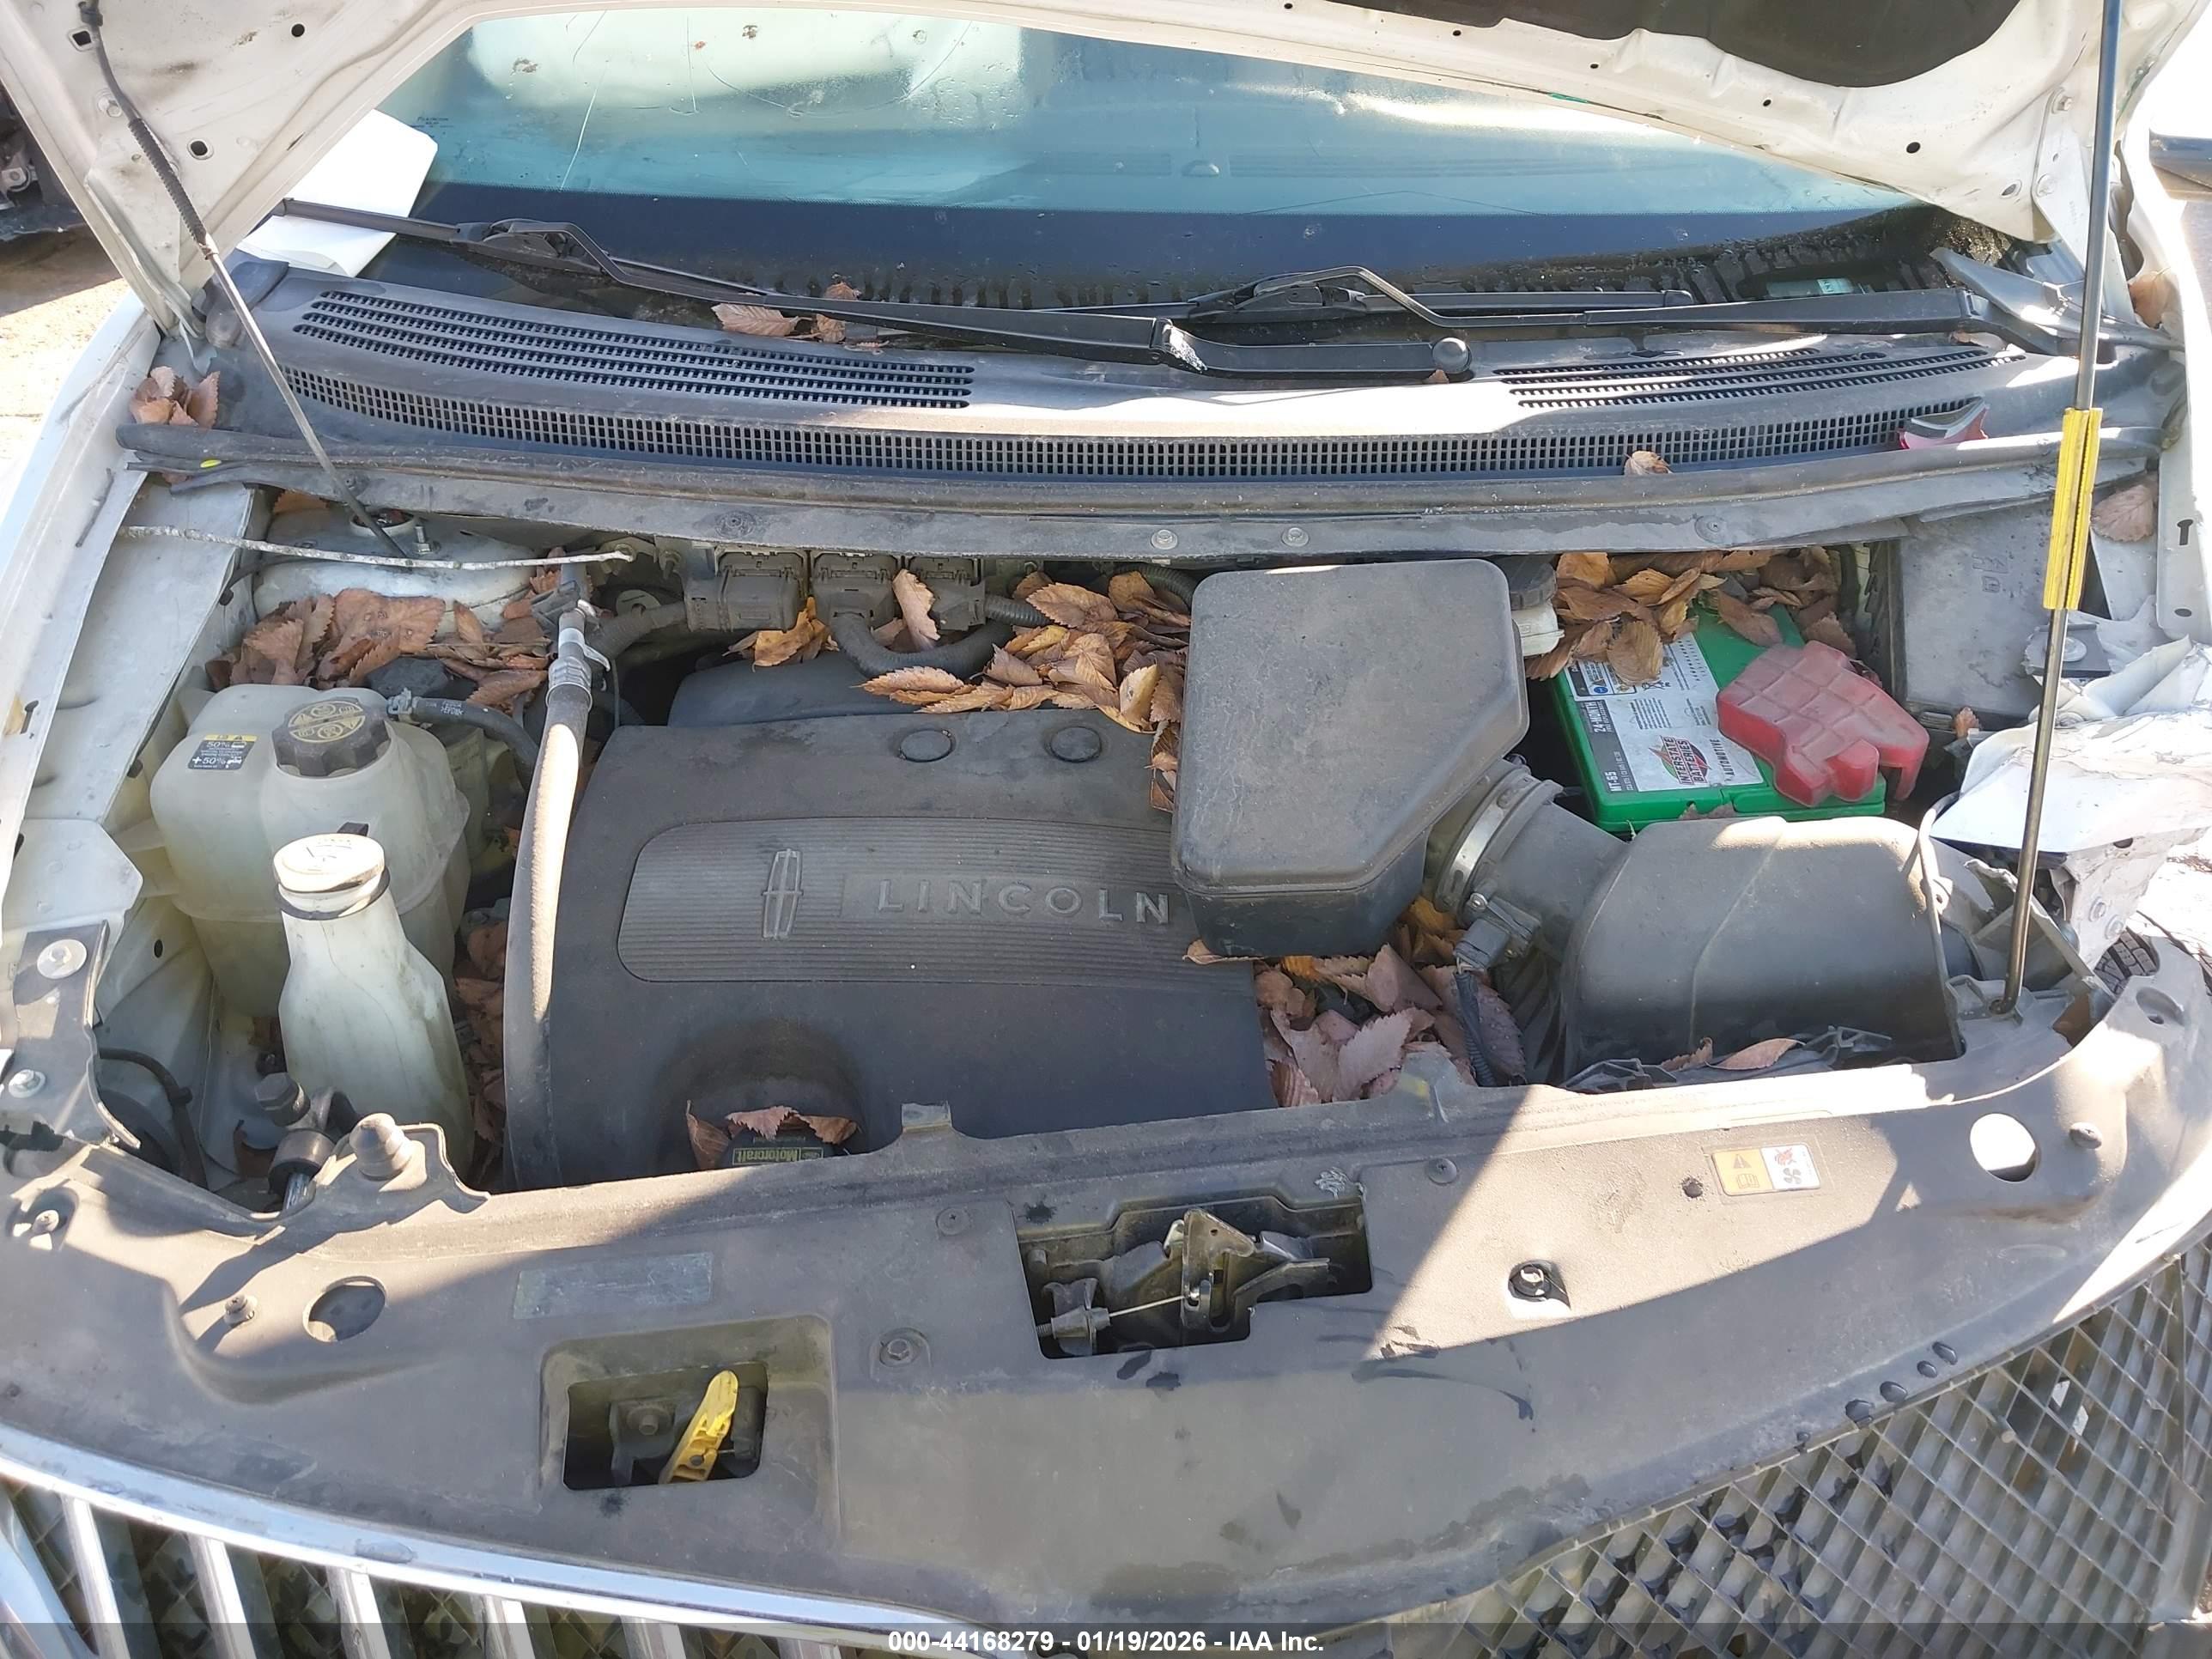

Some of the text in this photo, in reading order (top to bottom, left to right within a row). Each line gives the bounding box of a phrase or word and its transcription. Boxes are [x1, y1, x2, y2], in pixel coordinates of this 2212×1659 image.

[1585, 702, 1607, 732] 24-MONTH
[1663, 737, 1690, 785] INTERSTATE
[1677, 738, 1704, 783] BATTERIES
[1710, 738, 1735, 775] AUTOMOTIVE
[1604, 770, 1622, 792] MT-65
[878, 878, 1170, 925] LINCOLN
[738, 1148, 798, 1163] Motorcraft
